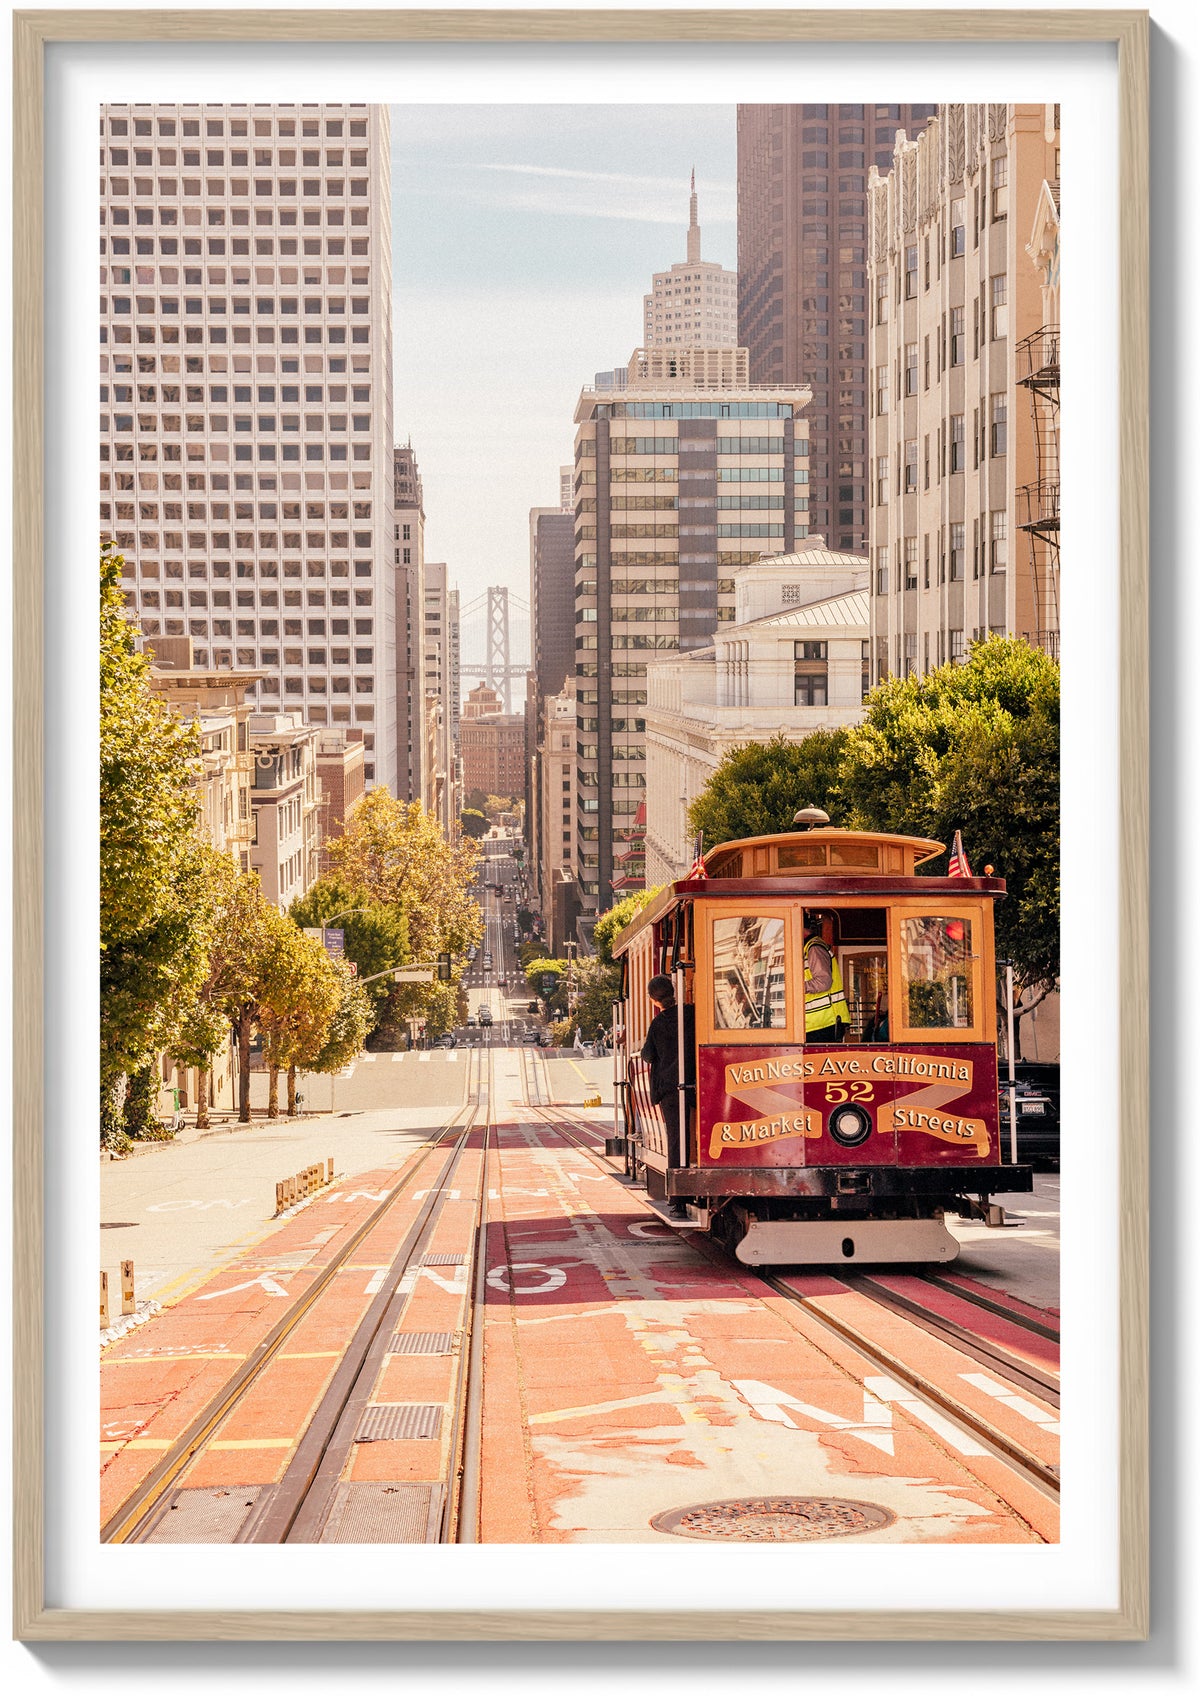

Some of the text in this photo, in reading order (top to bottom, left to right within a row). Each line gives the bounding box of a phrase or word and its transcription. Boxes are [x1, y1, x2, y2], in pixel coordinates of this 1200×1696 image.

[729, 1066, 765, 1085] Van
[766, 1059, 815, 1082] Ness
[872, 1055, 970, 1081] California
[824, 1080, 875, 1103] 52
[720, 1113, 813, 1143] & Market
[893, 1107, 976, 1138] Streets
